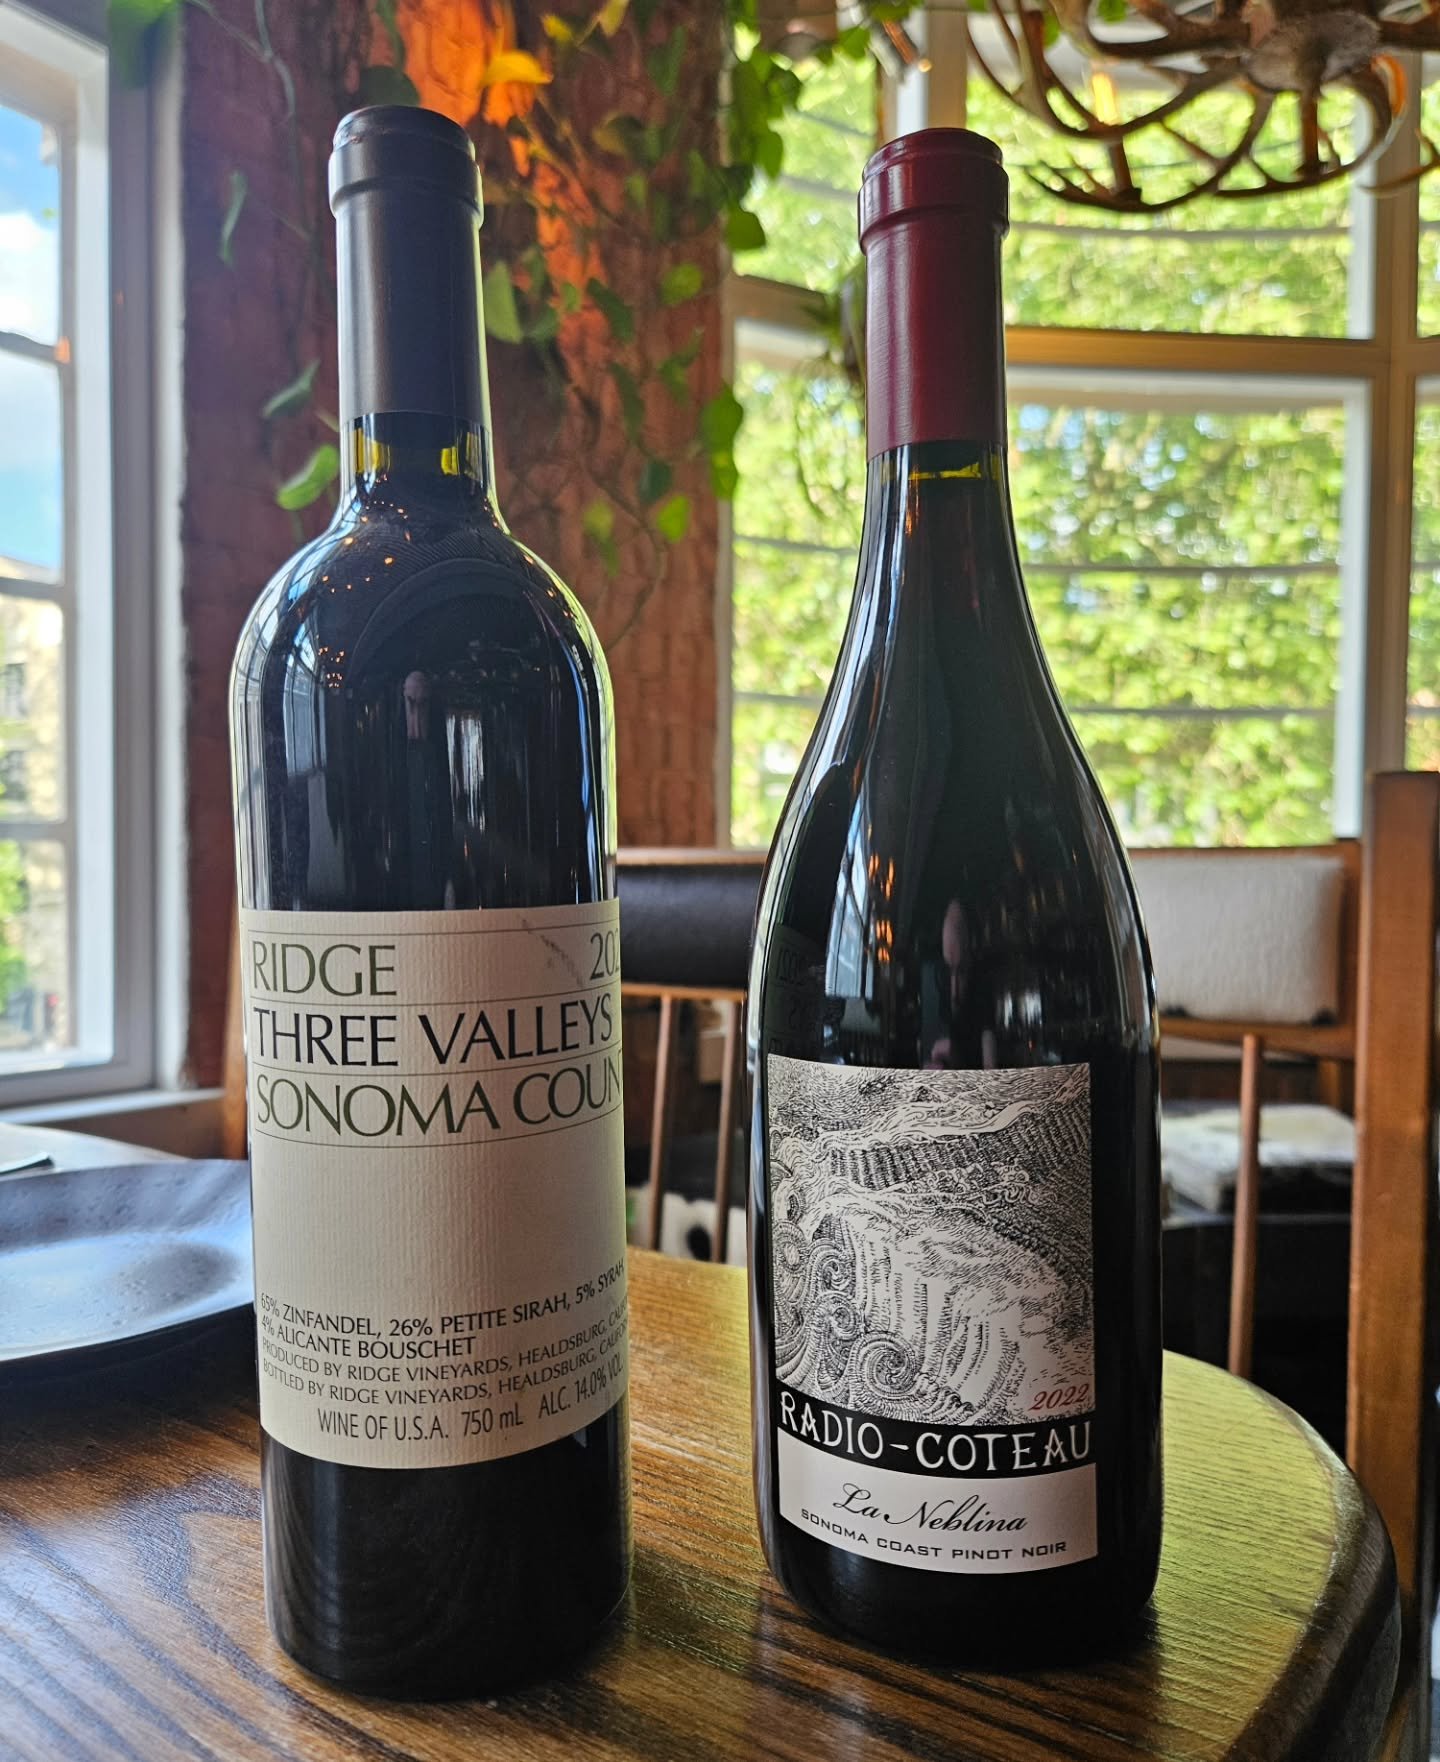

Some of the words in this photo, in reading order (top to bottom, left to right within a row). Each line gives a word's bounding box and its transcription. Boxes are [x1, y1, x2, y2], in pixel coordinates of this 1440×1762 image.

[252, 940, 397, 996] RIDGE
[253, 1006, 398, 1067] THREE
[418, 992, 613, 1065] VALLEYS
[257, 1074, 501, 1137] SONOMA
[513, 1047, 622, 1125] COUN
[261, 1292, 280, 1317] 65%
[283, 1303, 381, 1339] ZINFANDEL,
[389, 1317, 433, 1337] 26%
[440, 1307, 507, 1335] PETITE
[513, 1292, 571, 1325] SIRAH,
[575, 1281, 596, 1305] 5%
[262, 1314, 275, 1336] 4%
[277, 1323, 352, 1357] ALICANTE
[359, 1336, 476, 1360] BOUSCHET
[262, 1336, 319, 1373] PRODUCED
[324, 1361, 342, 1378] BY
[348, 1365, 401, 1383] RIDGE
[405, 1356, 513, 1383] VINEYARDS,
[518, 1320, 607, 1367] HEALDSBURG,
[263, 1358, 305, 1391] BOTTLED
[308, 1380, 325, 1397] BY
[330, 1385, 380, 1404] RIDGE
[385, 1384, 492, 1405] VINEYARDS,
[498, 1348, 597, 1395] HEALDSBURG,
[317, 1408, 359, 1438] WINE
[365, 1414, 388, 1440] OF
[394, 1415, 449, 1441] U.S.A.
[461, 1408, 494, 1438] 750
[500, 1402, 524, 1430] mL
[538, 1386, 571, 1419] ALC.
[574, 1364, 607, 1403] 14.0%
[1027, 1383, 1090, 1413] 2022
[781, 1390, 1091, 1472] RADIO-COTEAU
[801, 1508, 869, 1545] SONOMA
[877, 1537, 942, 1558] COAST
[952, 1547, 1013, 1561] PINOT
[1022, 1541, 1067, 1557] NOIR
[832, 1482, 882, 1519] La
[884, 1494, 1028, 1532] Neblina
